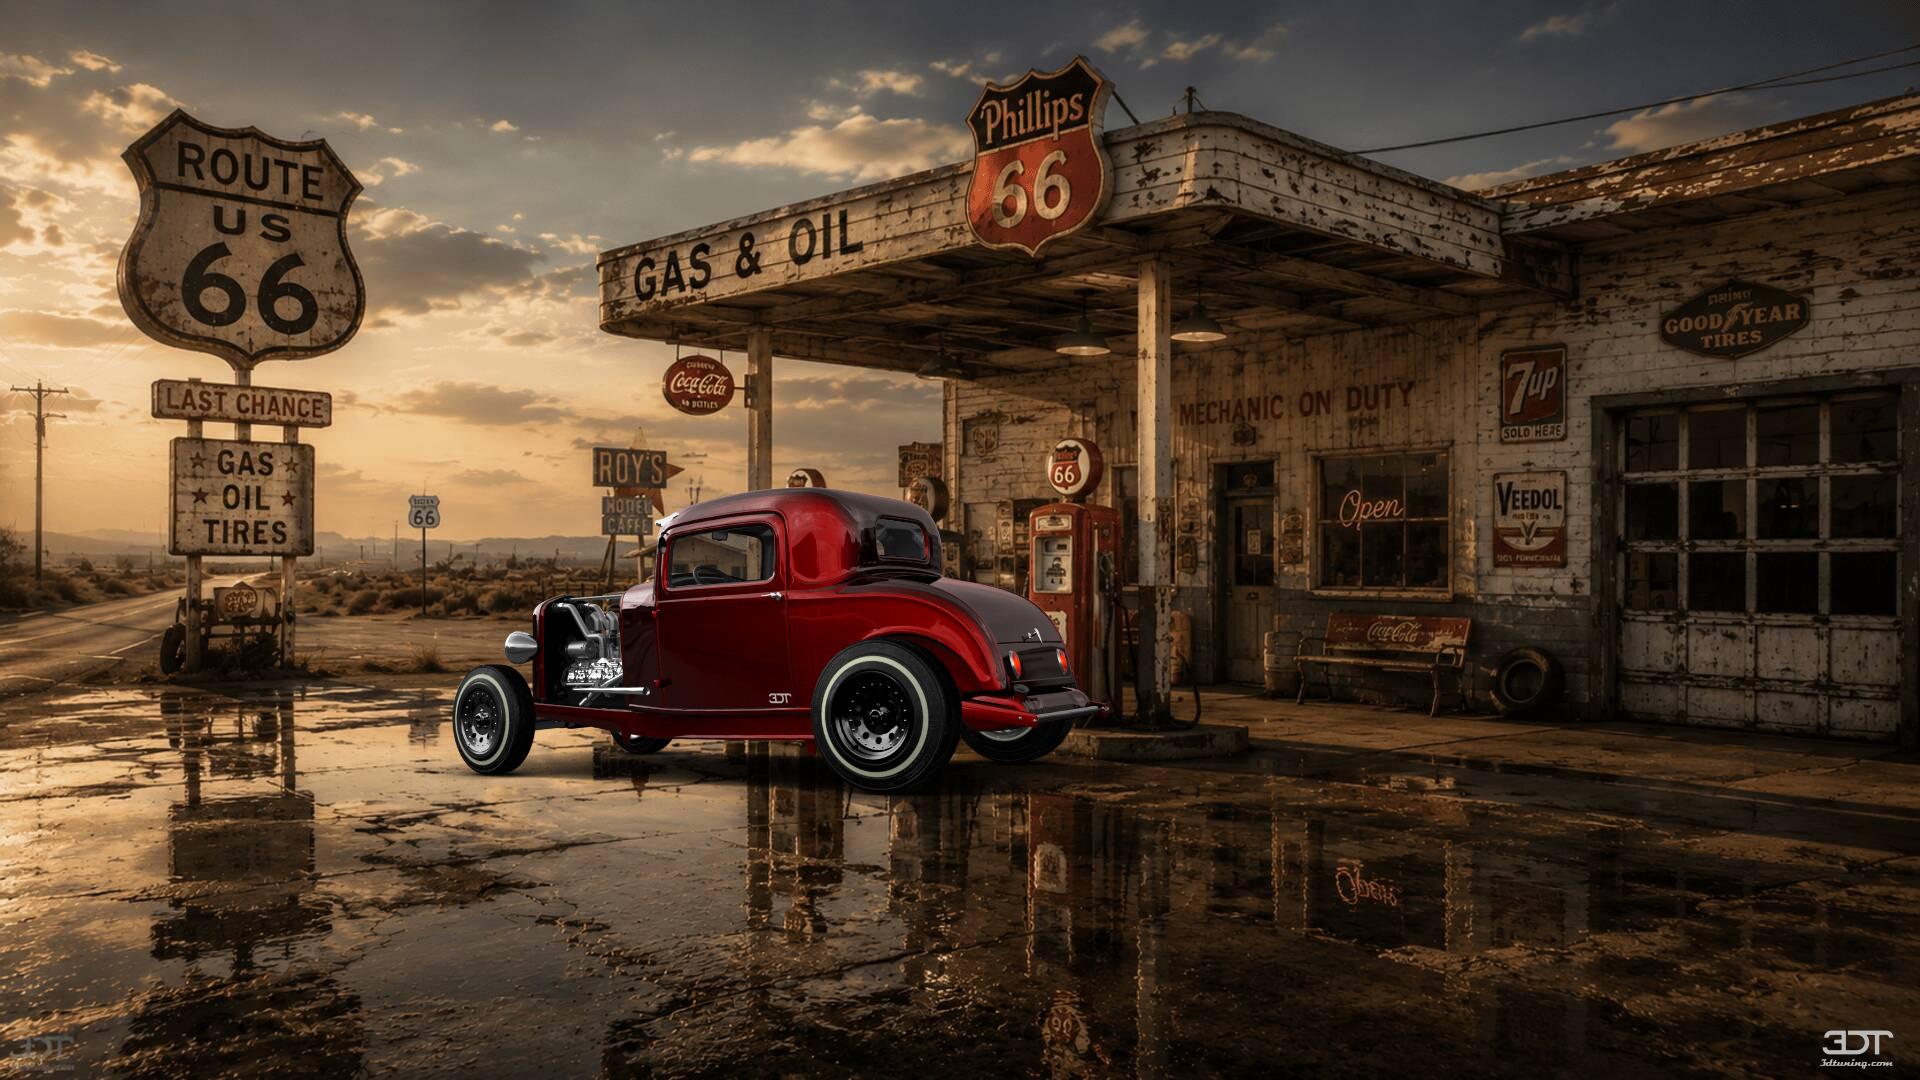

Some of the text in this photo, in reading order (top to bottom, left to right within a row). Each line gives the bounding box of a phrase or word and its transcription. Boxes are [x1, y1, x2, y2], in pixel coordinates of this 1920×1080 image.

[980, 90, 1083, 144] Phillips
[178, 141, 324, 200] ROUTE
[991, 150, 1071, 229] 66
[213, 205, 291, 242] US
[634, 209, 864, 302] GAS & OIL
[181, 242, 318, 335] 66
[1700, 330, 1762, 349] TIRES
[166, 387, 324, 418] LAST CHANCE
[1180, 381, 1415, 426] MECHANIC ON DUTY
[1503, 426, 1530, 439] SOLD
[217, 449, 274, 476] GAS
[599, 451, 663, 484] ROY'S
[1054, 465, 1075, 484] 66
[222, 484, 270, 510] OIL
[1340, 490, 1403, 531] Open
[203, 519, 287, 545] TIRES
[414, 510, 435, 525] 66
[768, 692, 792, 704] 3DT
